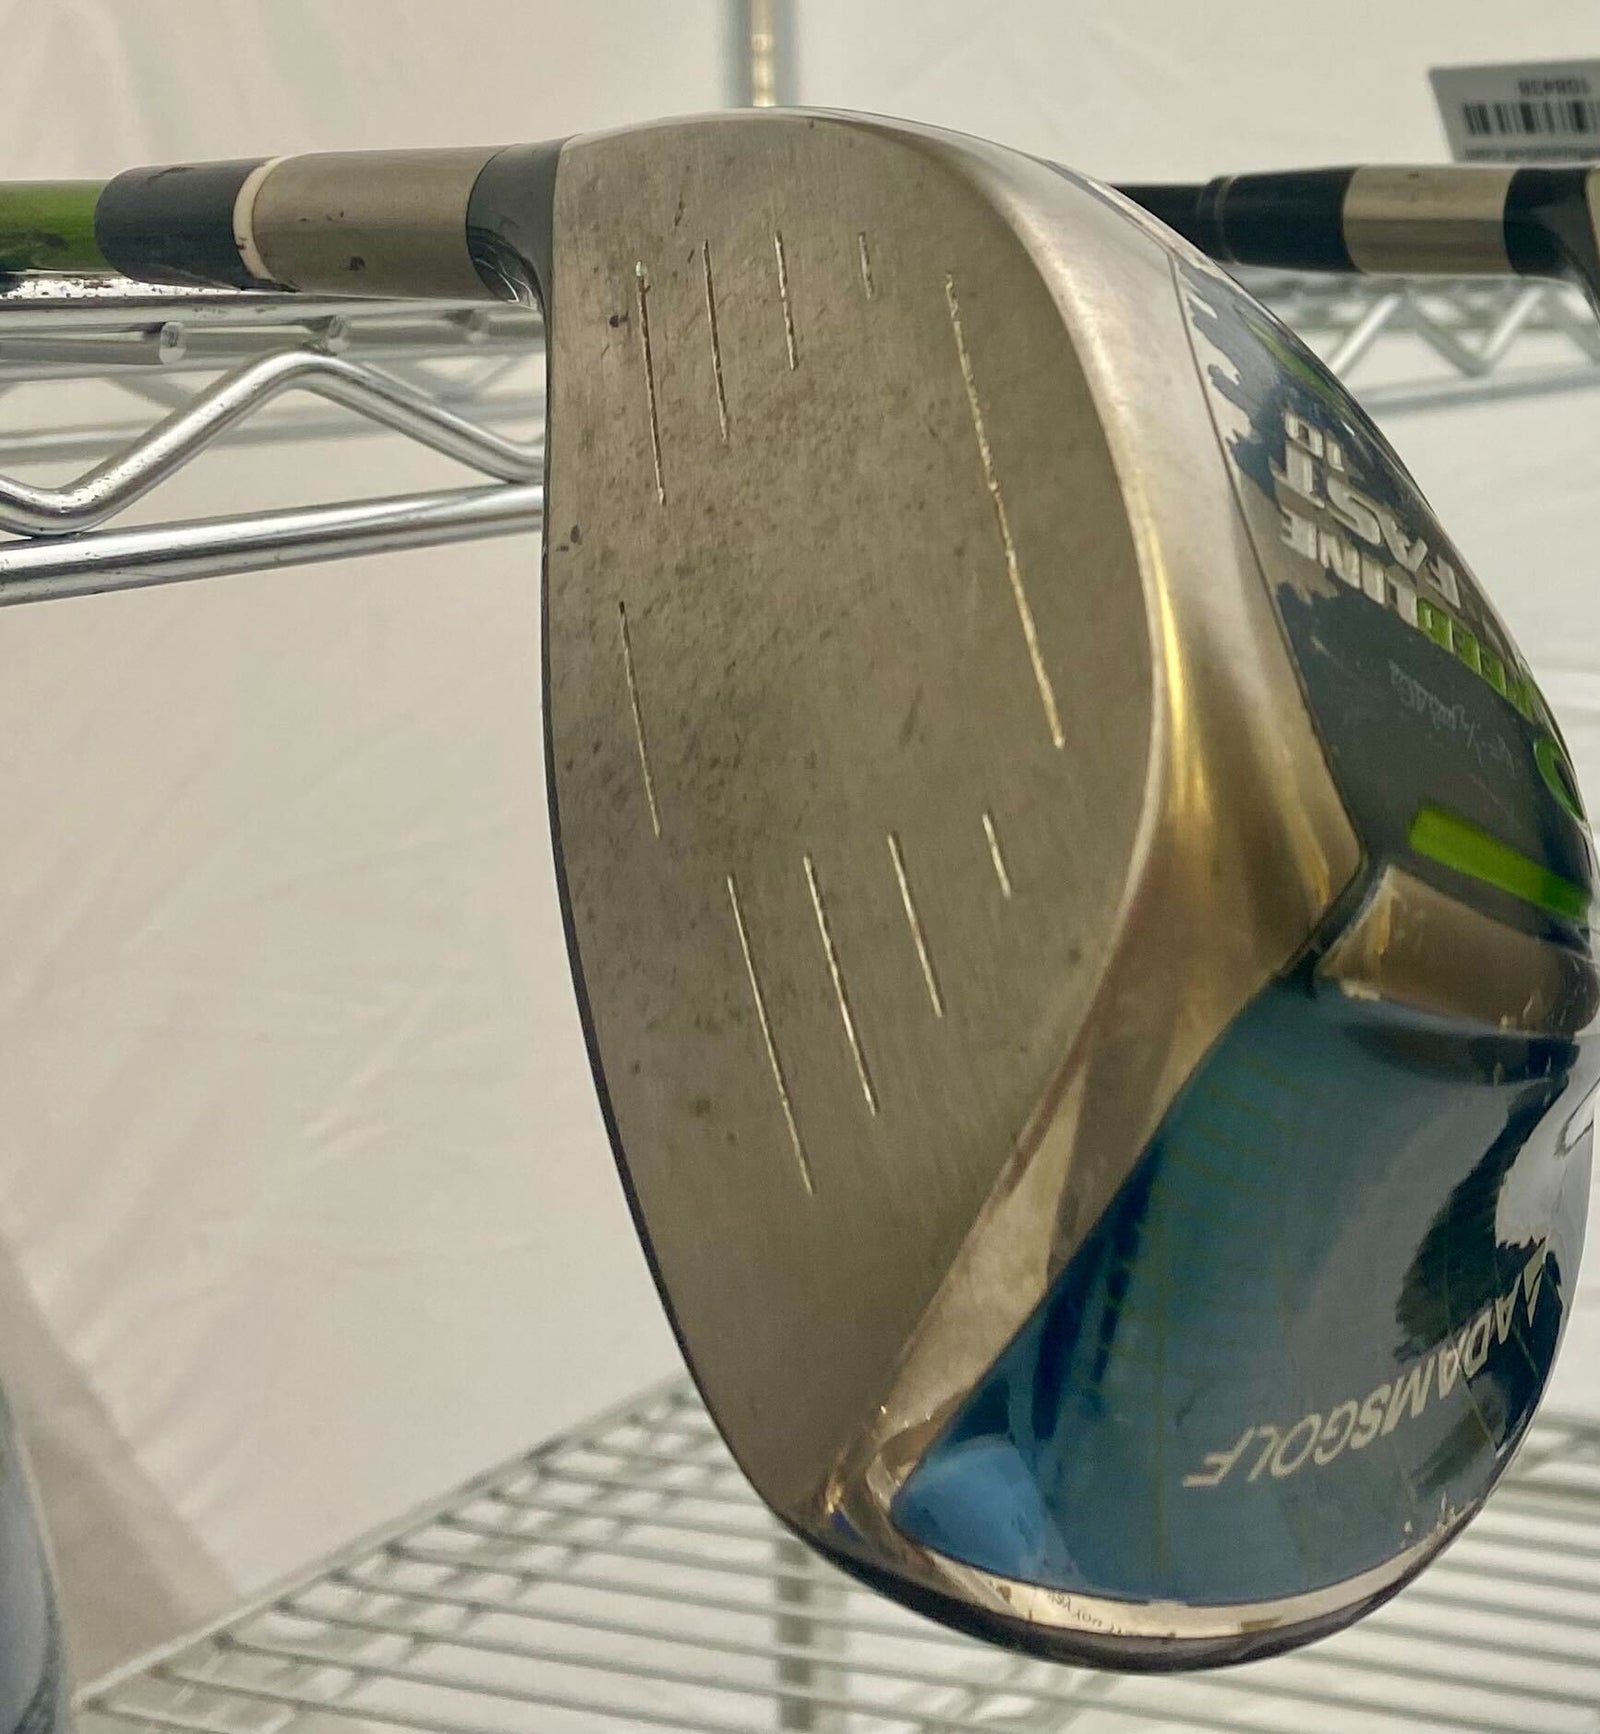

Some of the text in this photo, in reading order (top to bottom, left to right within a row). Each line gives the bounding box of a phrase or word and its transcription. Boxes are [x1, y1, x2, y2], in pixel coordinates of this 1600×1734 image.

[1268, 441, 1462, 610] FAST
[1283, 409, 1344, 473] 10
[1182, 1272, 1525, 1488] ADAMSGOLF
